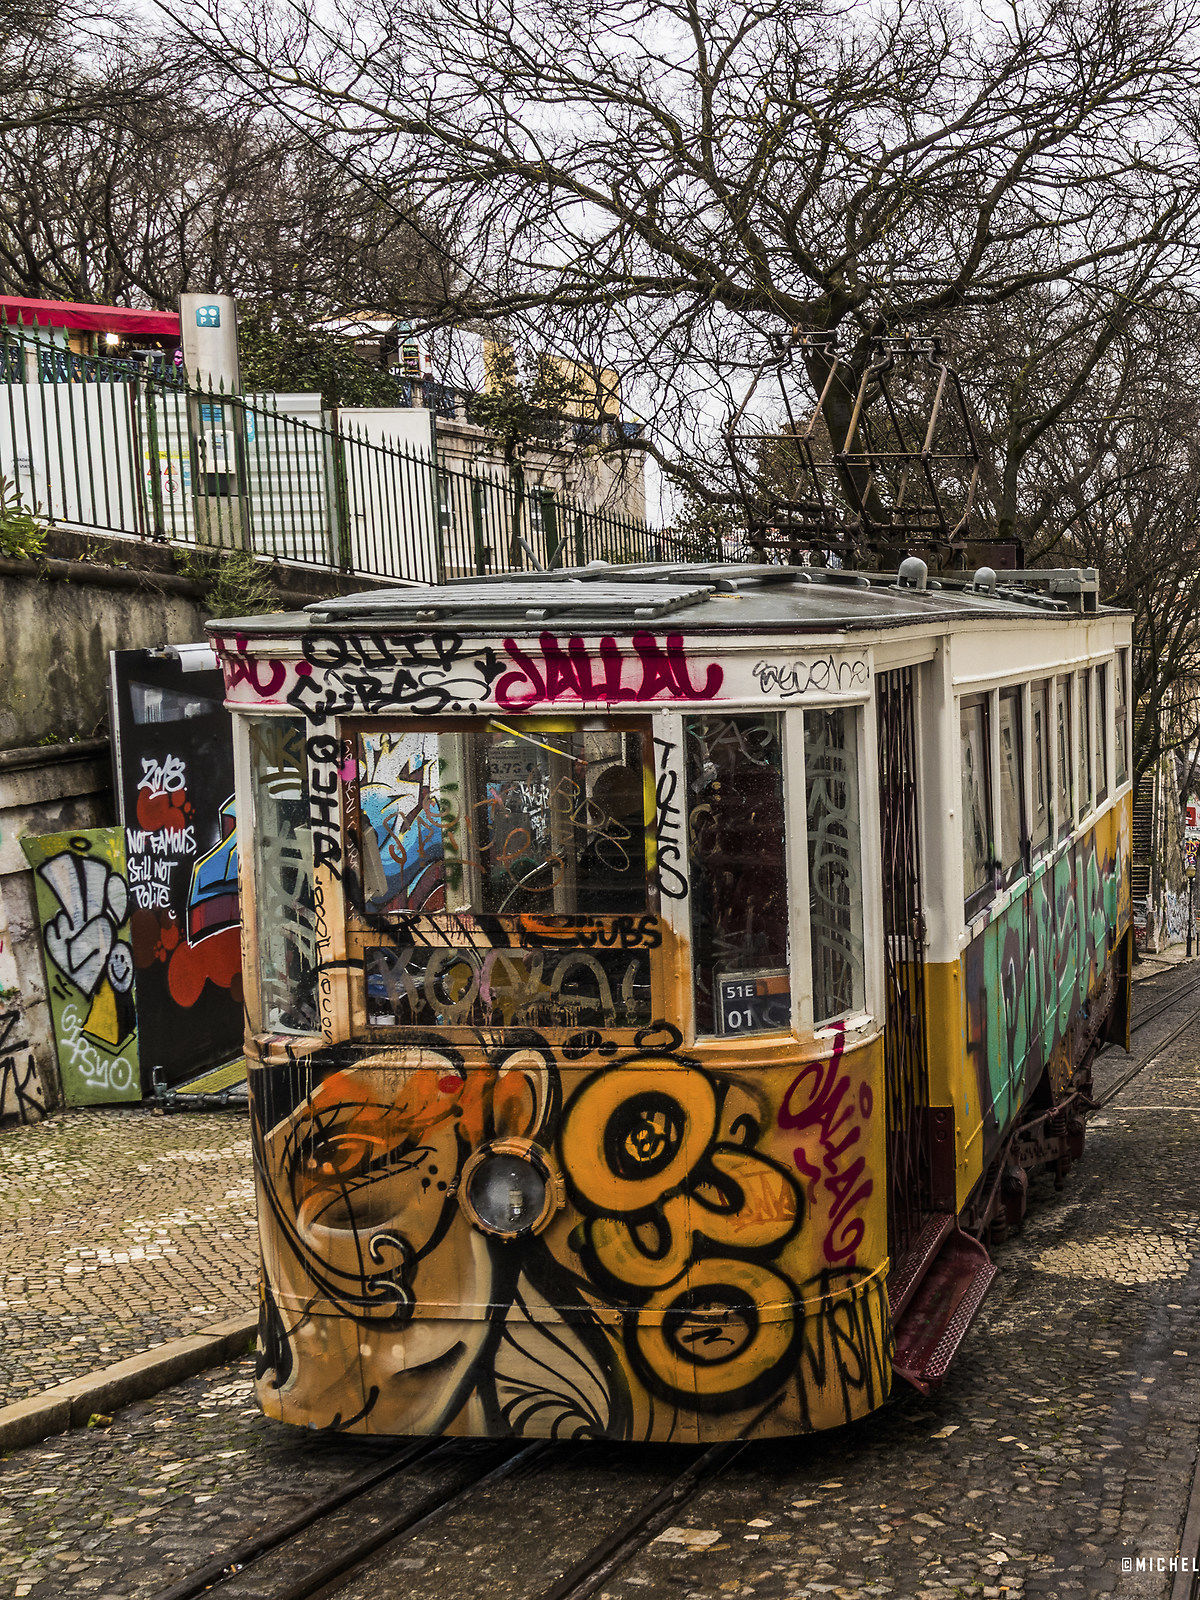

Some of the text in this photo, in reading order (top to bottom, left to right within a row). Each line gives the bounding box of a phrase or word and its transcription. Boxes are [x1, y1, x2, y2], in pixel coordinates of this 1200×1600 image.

[126, 827, 153, 854] NOT
[154, 858, 178, 885] NOT
[726, 984, 754, 999] 51E
[728, 1009, 753, 1029] 01
